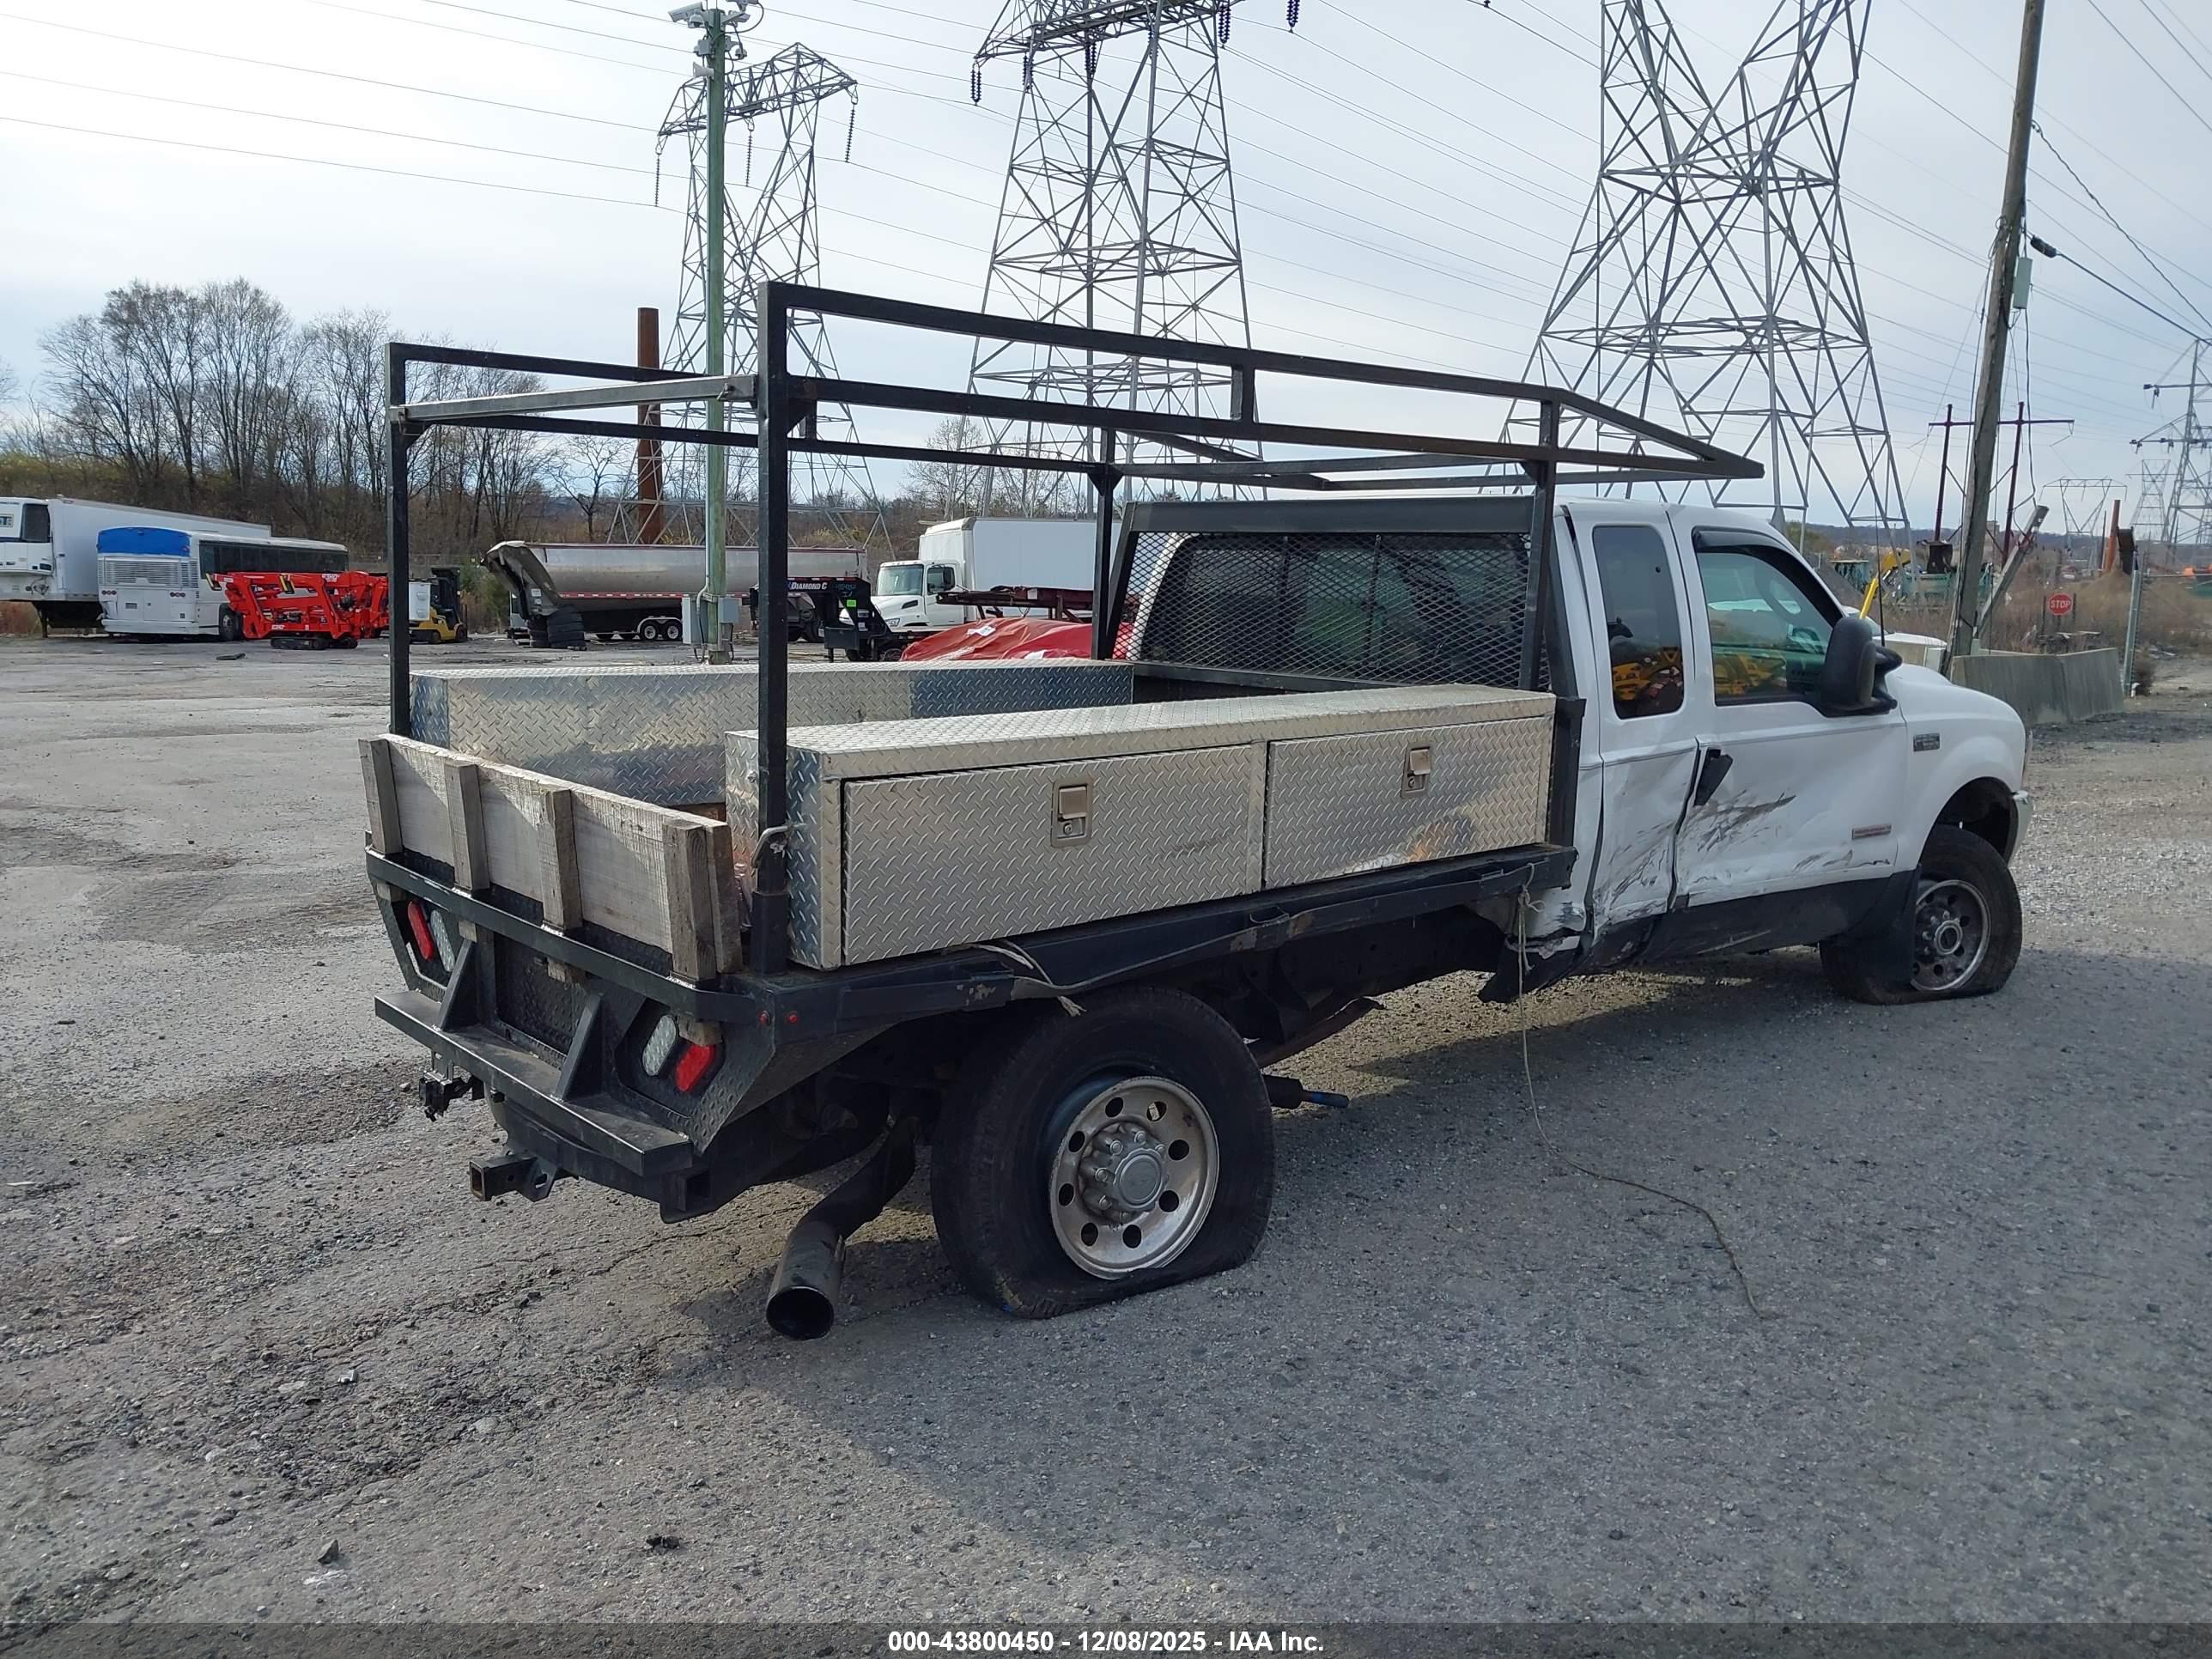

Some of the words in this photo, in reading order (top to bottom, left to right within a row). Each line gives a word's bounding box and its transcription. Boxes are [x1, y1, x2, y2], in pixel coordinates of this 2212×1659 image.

[791, 581, 821, 590] DIAMOND
[822, 581, 828, 590] C
[2051, 599, 2070, 609] STOP
